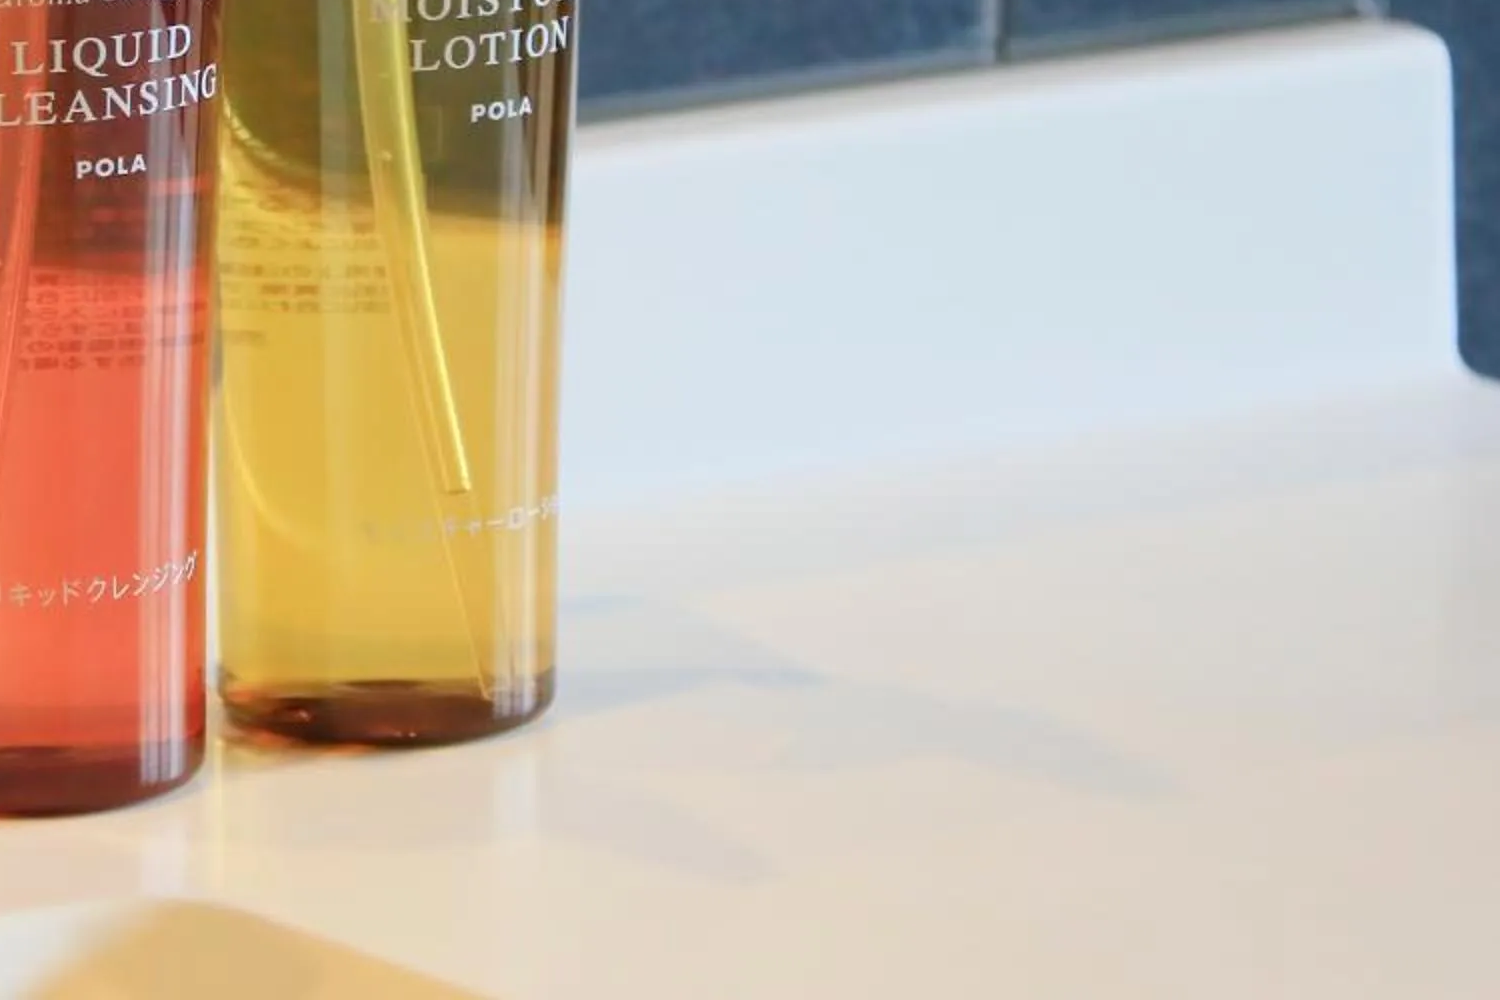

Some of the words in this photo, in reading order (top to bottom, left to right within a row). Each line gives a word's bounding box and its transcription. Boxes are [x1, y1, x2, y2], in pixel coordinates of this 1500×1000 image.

[10, 23, 192, 78] LIQUID
[409, 16, 572, 72] LOTION
[470, 95, 534, 124] POLA
[74, 153, 148, 180] POLA
